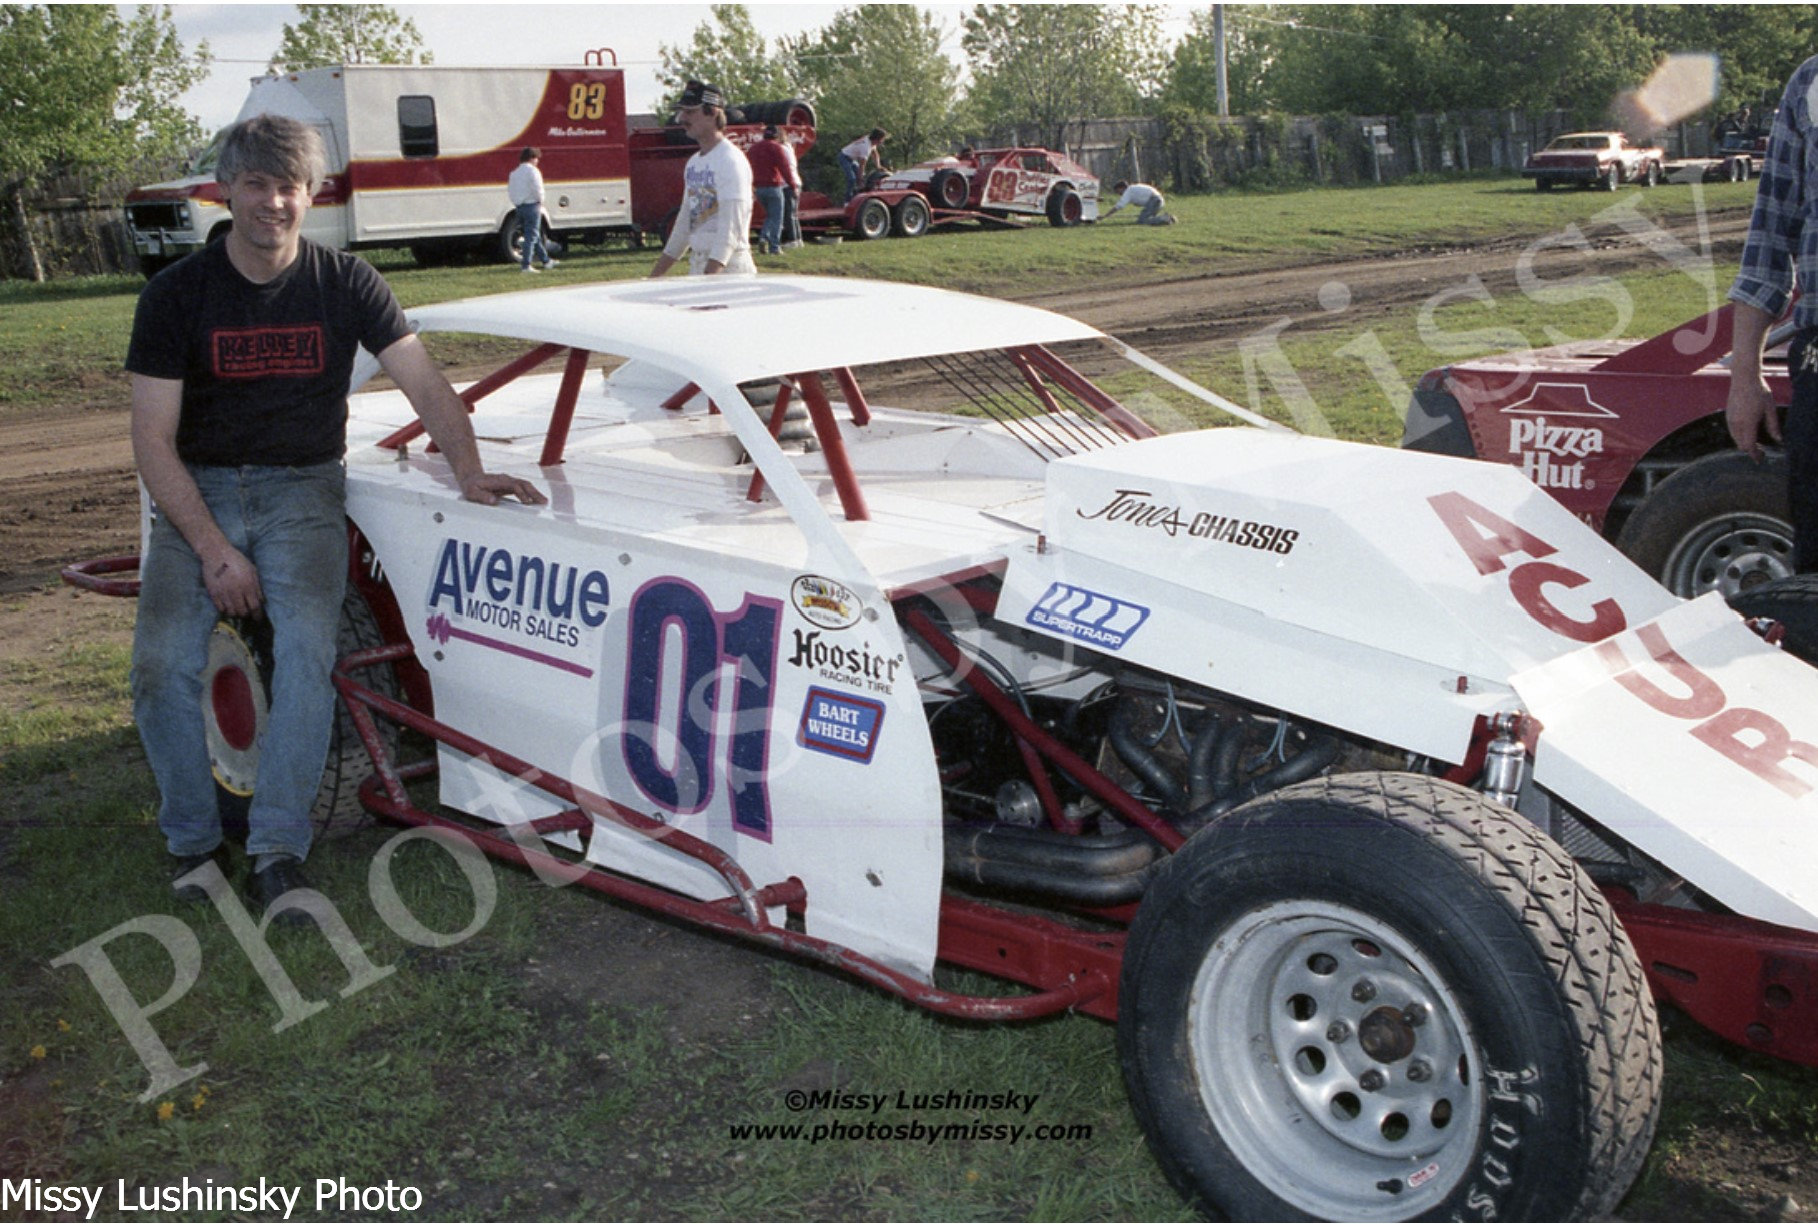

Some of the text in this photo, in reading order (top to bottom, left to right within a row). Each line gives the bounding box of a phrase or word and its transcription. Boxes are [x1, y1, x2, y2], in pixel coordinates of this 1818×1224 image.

[567, 82, 607, 120] 83
[1508, 416, 1604, 458] Pizza
[1076, 489, 1300, 555] Jones CHASSIS
[429, 538, 610, 628] Avenue
[465, 598, 580, 648] MOTOR SALES
[1032, 612, 1123, 647] SUPERTRAPP
[820, 668, 893, 696] RACING TIRE
[621, 575, 785, 845] 01
[818, 702, 860, 725] BART
[807, 718, 870, 747] WHEELS
